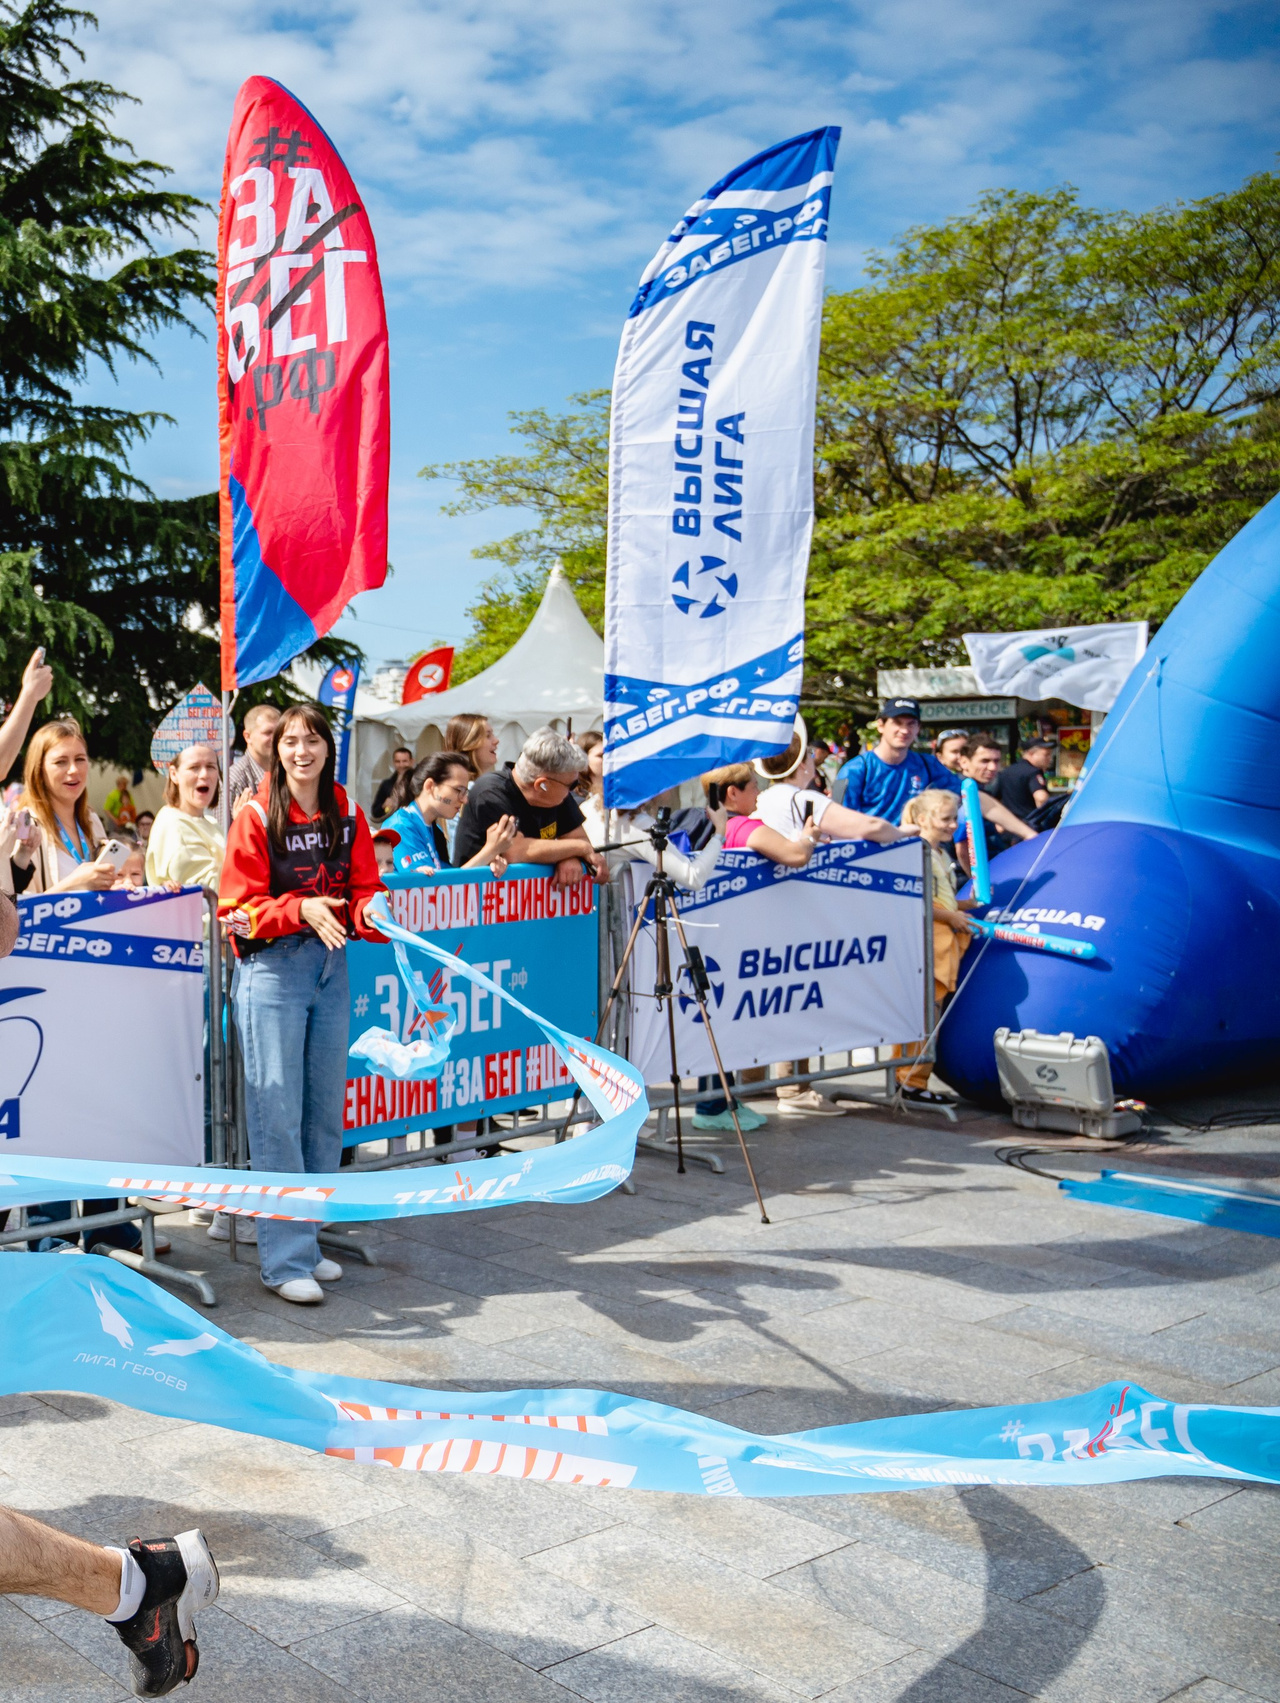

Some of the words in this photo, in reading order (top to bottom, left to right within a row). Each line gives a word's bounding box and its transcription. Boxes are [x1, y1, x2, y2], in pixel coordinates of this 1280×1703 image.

[228, 166, 345, 266] ЗА
[663, 199, 824, 290] ЗАБЕГ.РФ
[246, 348, 336, 432] .рф
[672, 320, 716, 538] ВЫСШАЯ
[713, 411, 746, 544] ЛИГА
[920, 701, 1011, 718] ОРОЖЕНОЕ
[391, 883, 478, 933] ВОБОДА
[15, 932, 112, 957] БЕГ.РФ
[738, 935, 887, 979] ВЫСШАЯ
[732, 981, 824, 1021] ЛИГА
[343, 1074, 438, 1130] ЕНАЛИН
[440, 1049, 521, 1110] #ЗАБЕГ
[73, 1352, 116, 1368] ЛИГА
[122, 1361, 188, 1391] ГЕРОЕВ
